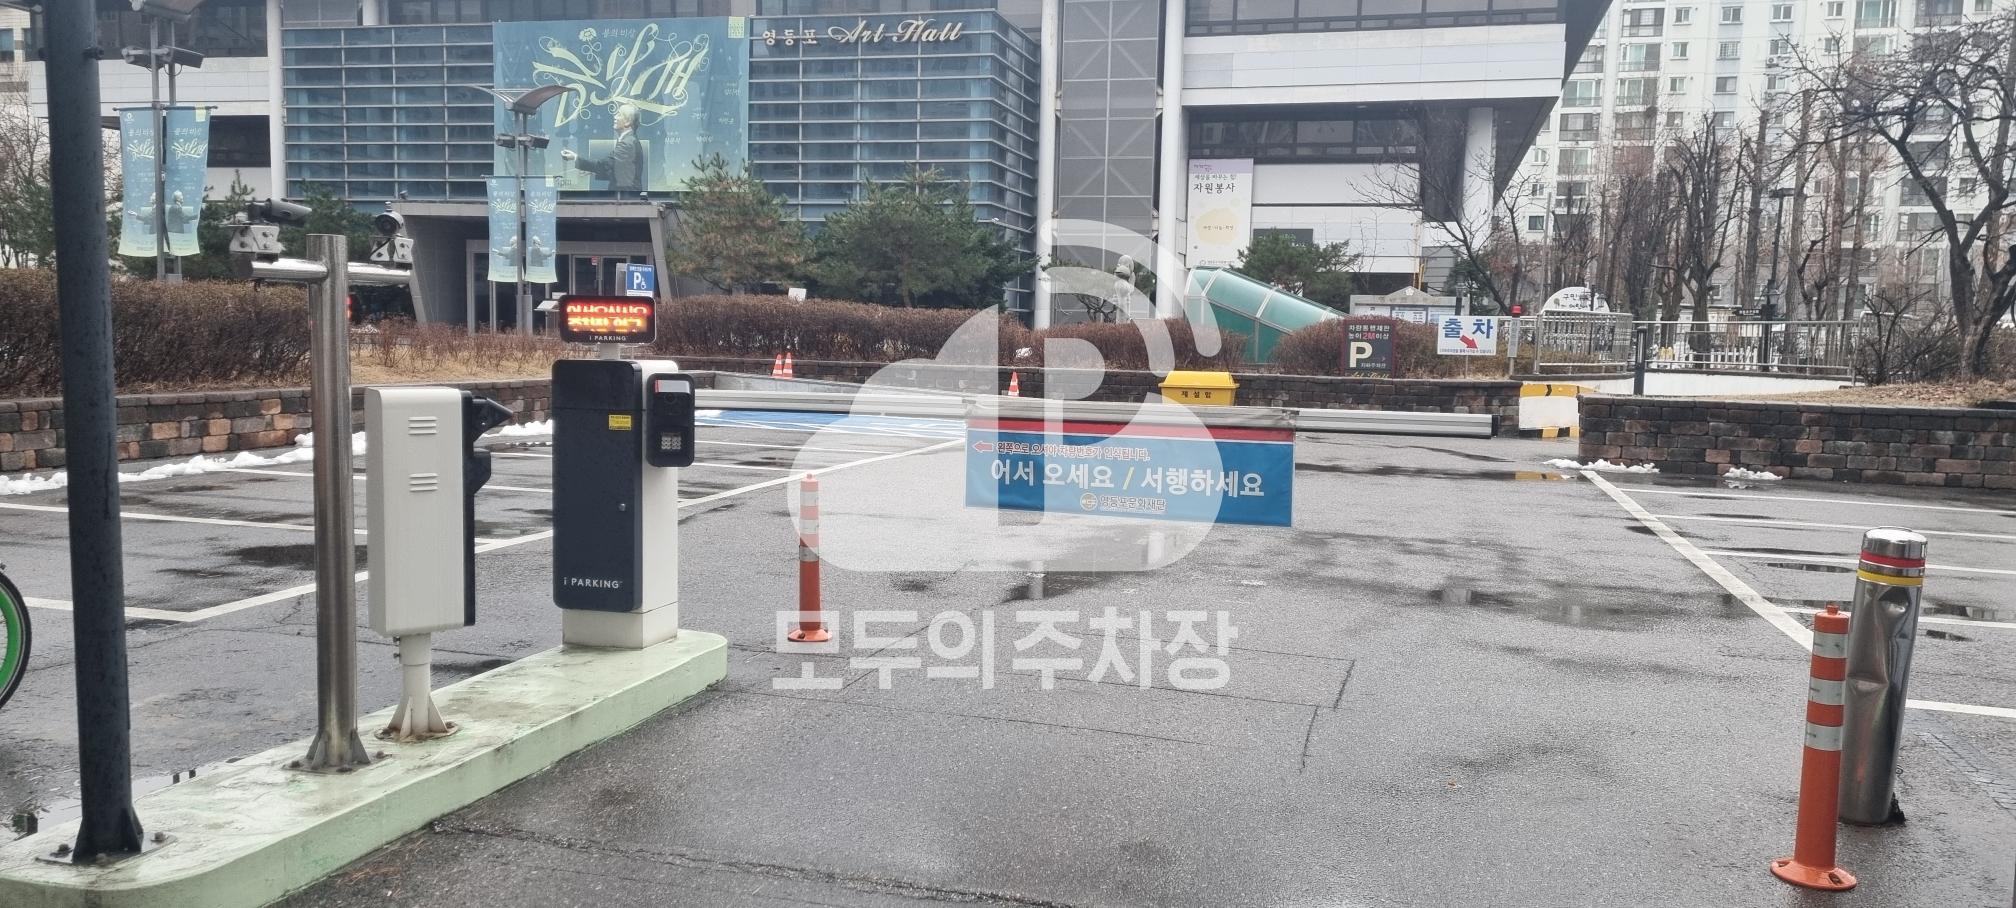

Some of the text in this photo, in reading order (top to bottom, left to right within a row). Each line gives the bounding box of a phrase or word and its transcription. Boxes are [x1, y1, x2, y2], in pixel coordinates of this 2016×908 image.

[762, 29, 817, 46] 영등포
[827, 20, 885, 43] Art
[892, 17, 964, 43] Hall
[1193, 182, 1236, 194] 자원봉사
[1349, 341, 1373, 368] P
[1181, 390, 1212, 399] 제설함
[997, 441, 1030, 455] 왼쪽으로
[1059, 444, 1103, 459] 차량번호가
[991, 459, 1034, 487] 어서
[1043, 463, 1115, 490] 오세요
[1141, 466, 1265, 498] 서행하세요
[1100, 495, 1166, 511] 영등포문화재단
[571, 577, 619, 589] PARKING
